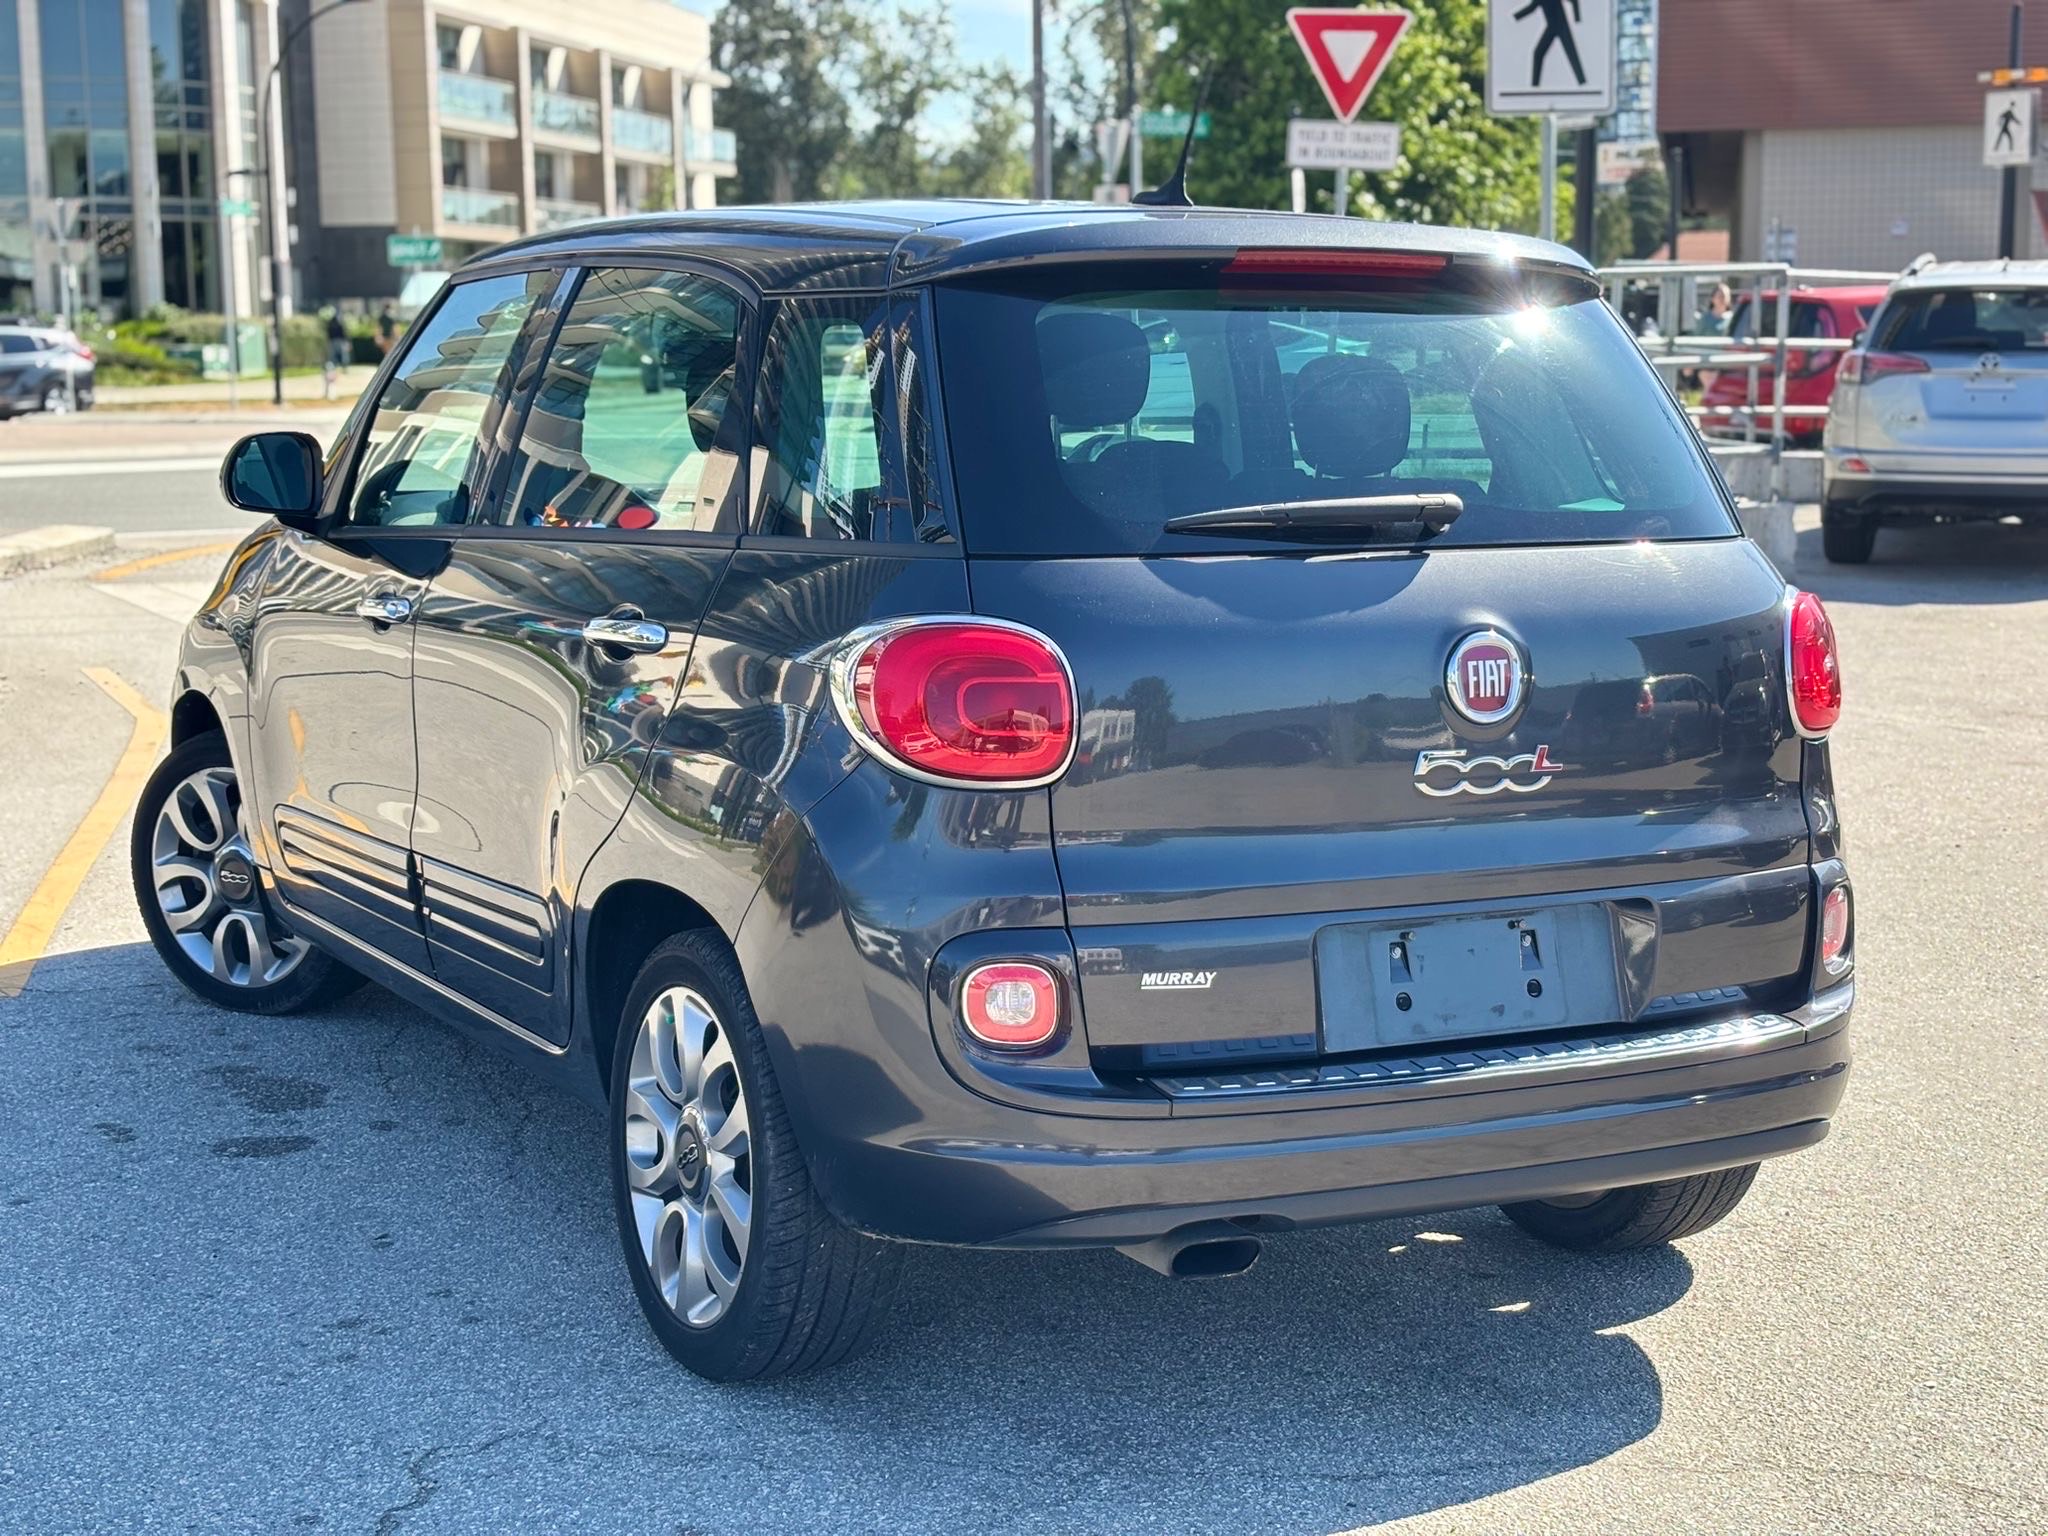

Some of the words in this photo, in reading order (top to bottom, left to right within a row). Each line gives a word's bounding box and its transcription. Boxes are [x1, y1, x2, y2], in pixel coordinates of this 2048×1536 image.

[1467, 659, 1508, 698] FIAT
[1414, 745, 1564, 797] 500L
[220, 870, 249, 884] 500
[1141, 971, 1217, 989] MURRAY
